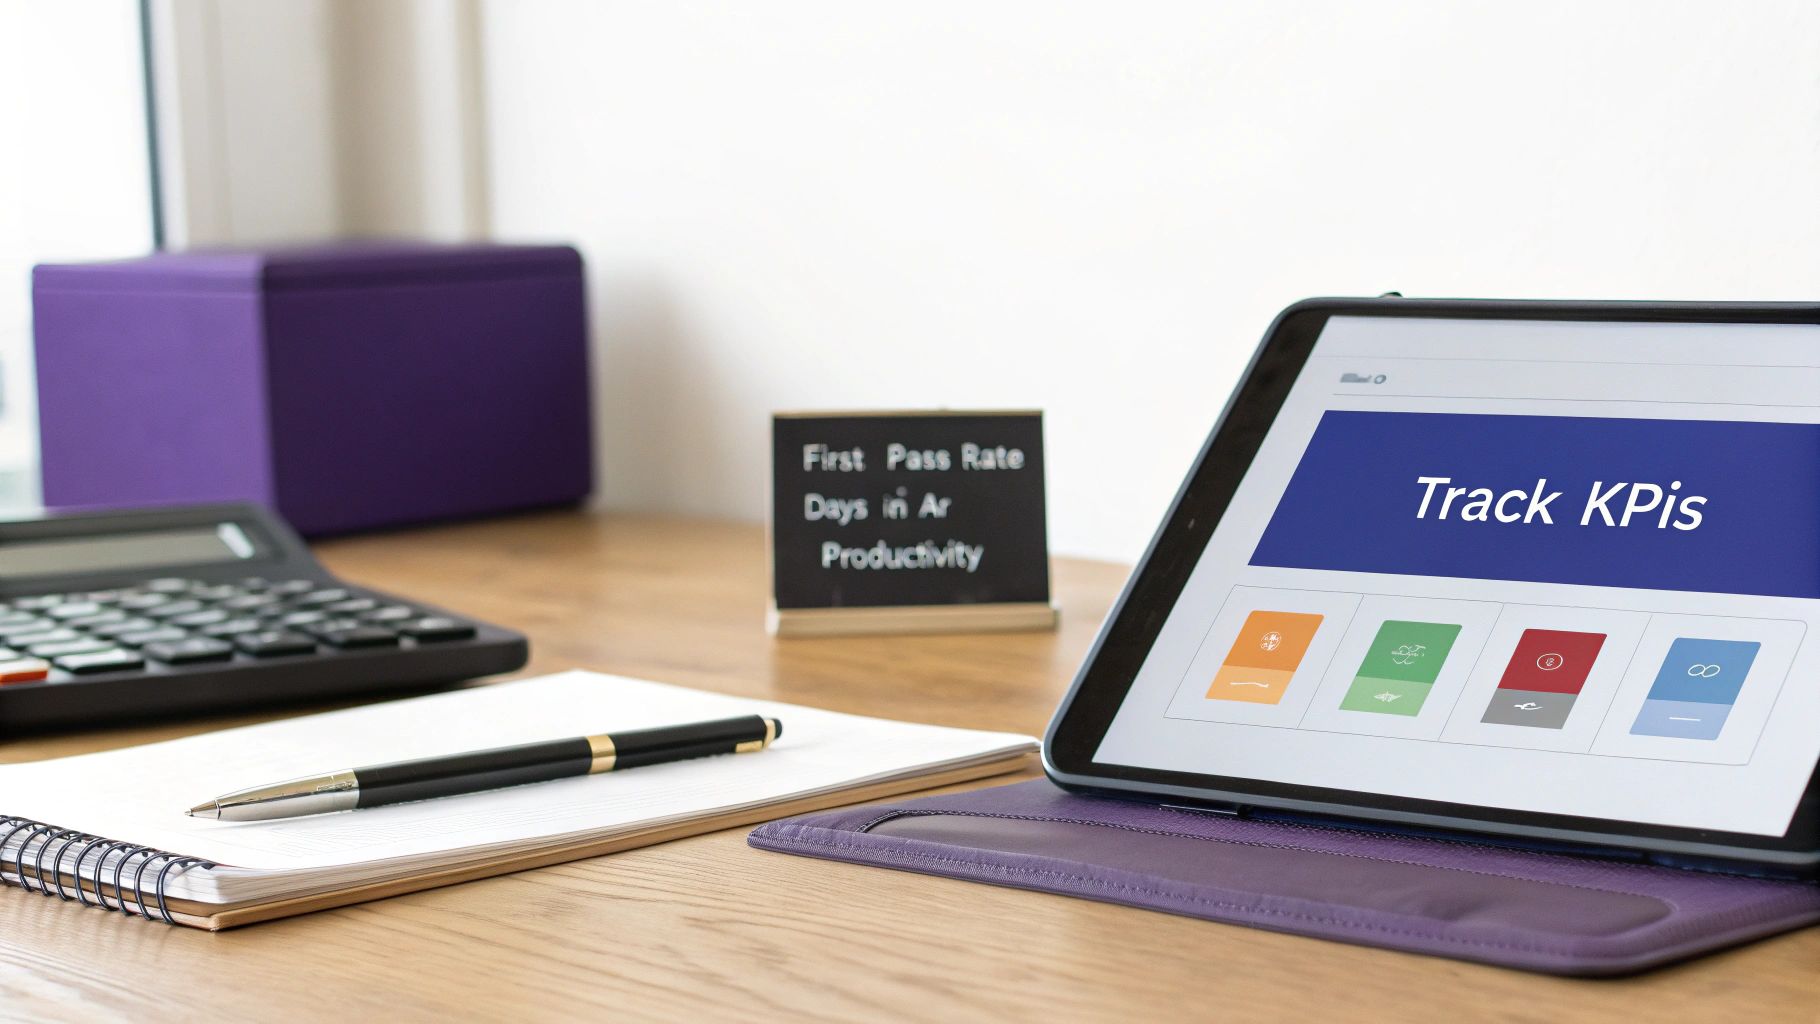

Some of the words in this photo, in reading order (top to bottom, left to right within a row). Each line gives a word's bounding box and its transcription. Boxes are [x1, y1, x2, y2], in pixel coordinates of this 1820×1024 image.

[803, 443, 866, 472] First
[886, 442, 951, 471] Pass
[961, 442, 1025, 471] Rate
[804, 493, 868, 526] Days
[882, 486, 909, 519] in
[918, 492, 952, 519] Ar
[1416, 476, 1563, 524] Track
[1580, 480, 1708, 531] KPis
[821, 539, 984, 573] Productivity
